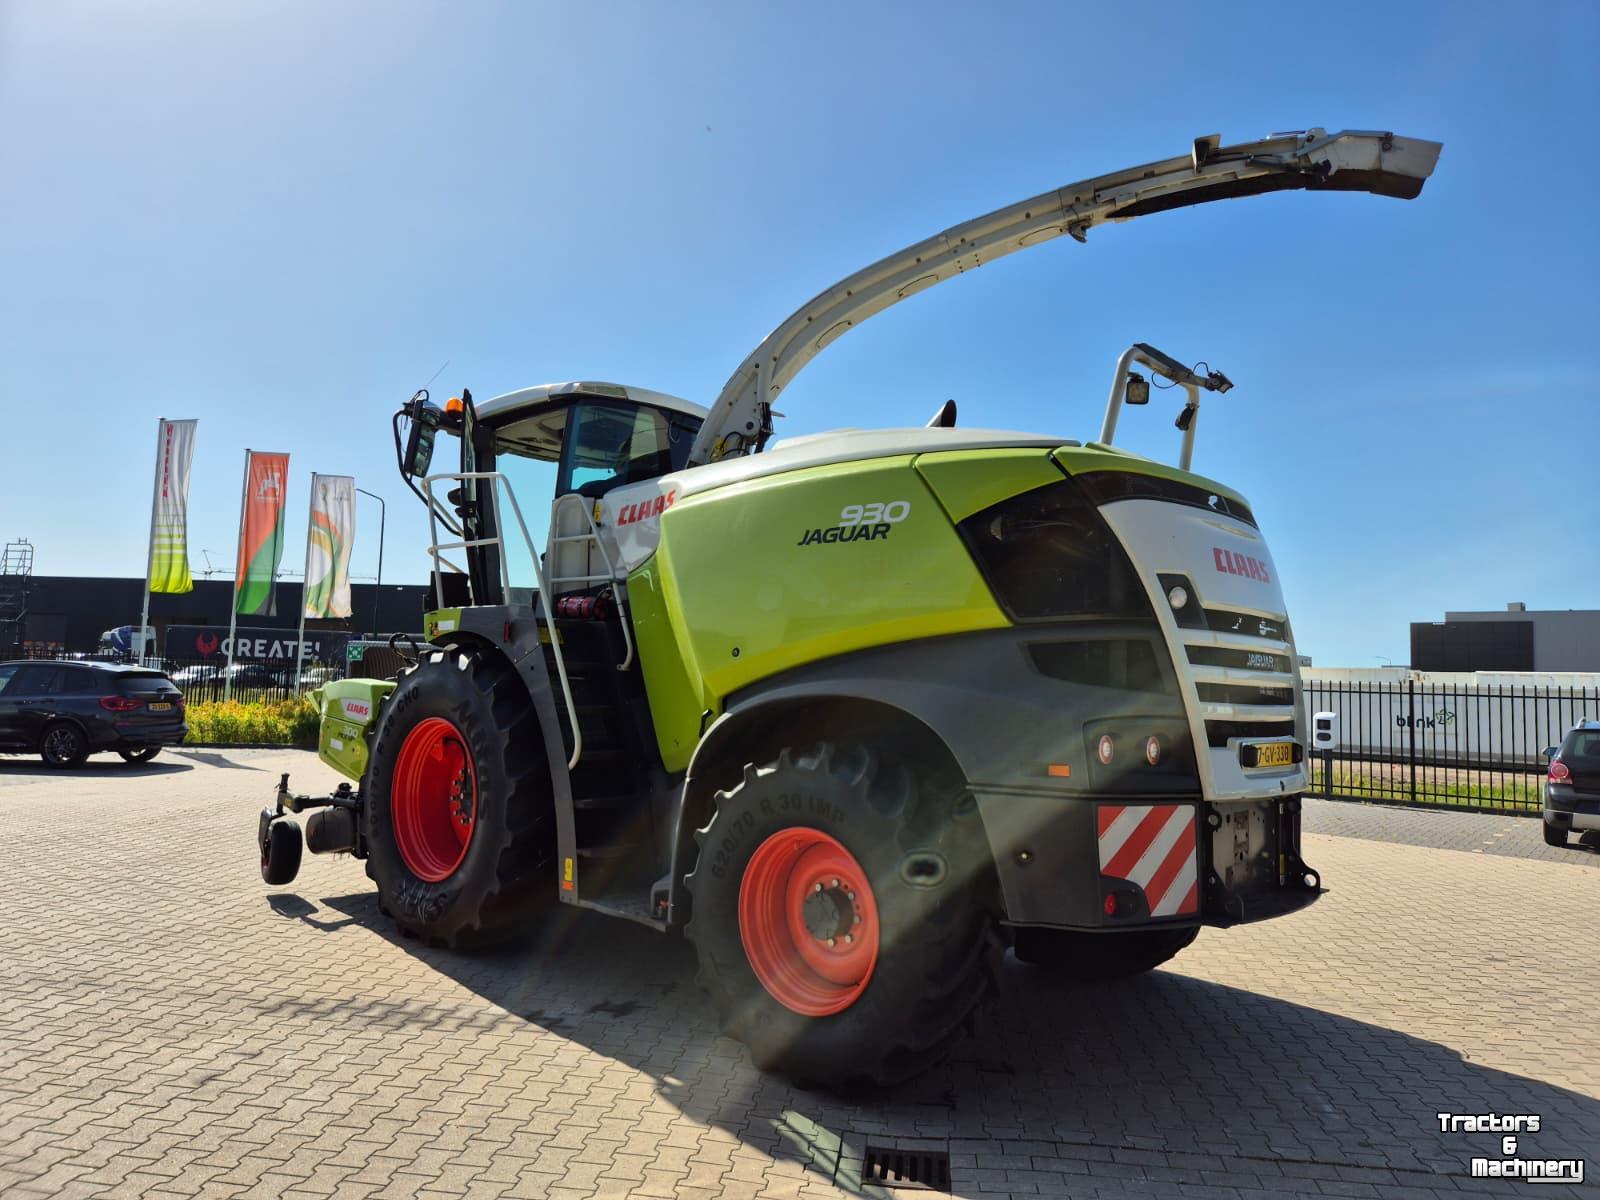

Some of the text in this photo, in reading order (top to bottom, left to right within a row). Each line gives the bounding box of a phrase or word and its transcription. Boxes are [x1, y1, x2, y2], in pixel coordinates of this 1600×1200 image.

[617, 490, 676, 526] CLAAS
[839, 501, 911, 527] 930
[797, 523, 891, 546] JAGUAR
[1212, 547, 1270, 584] CLAAS
[346, 703, 369, 716] CLAAS
